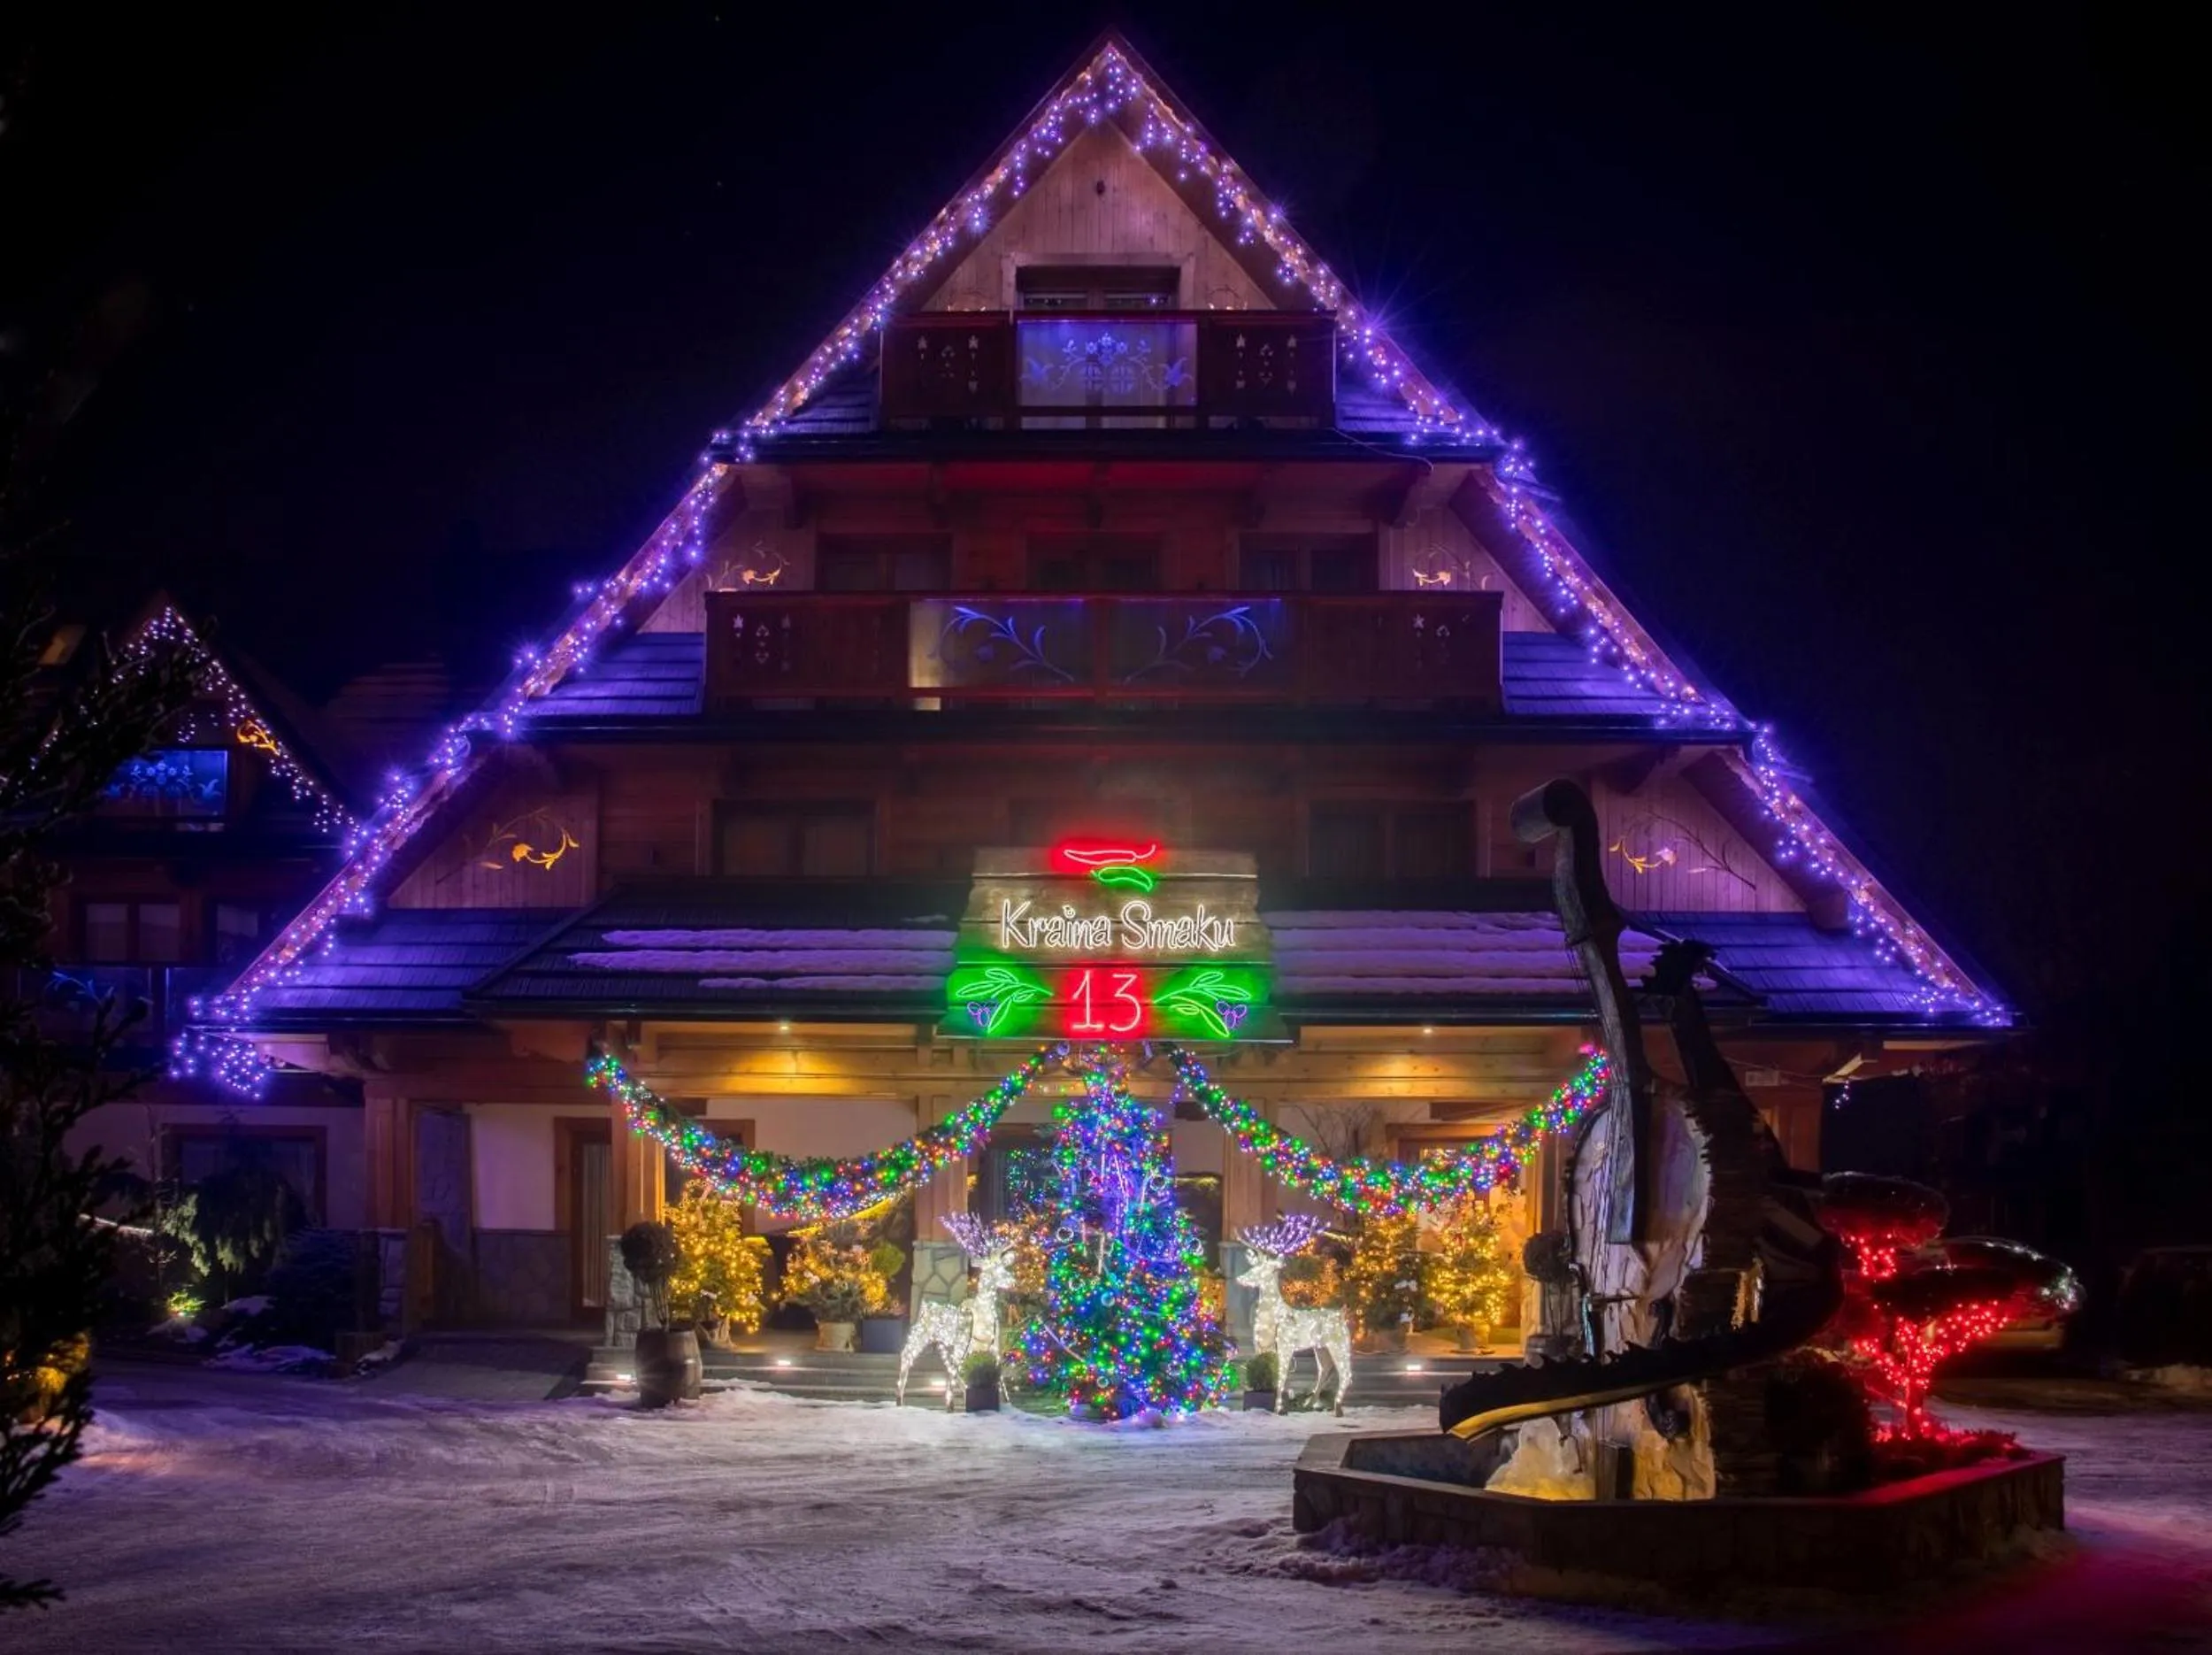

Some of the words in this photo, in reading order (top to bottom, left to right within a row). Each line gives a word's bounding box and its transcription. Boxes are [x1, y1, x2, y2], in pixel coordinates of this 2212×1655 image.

[1002, 898, 1112, 950] Kraina
[1120, 900, 1237, 951] Smaku
[1072, 970, 1141, 1032] 13
